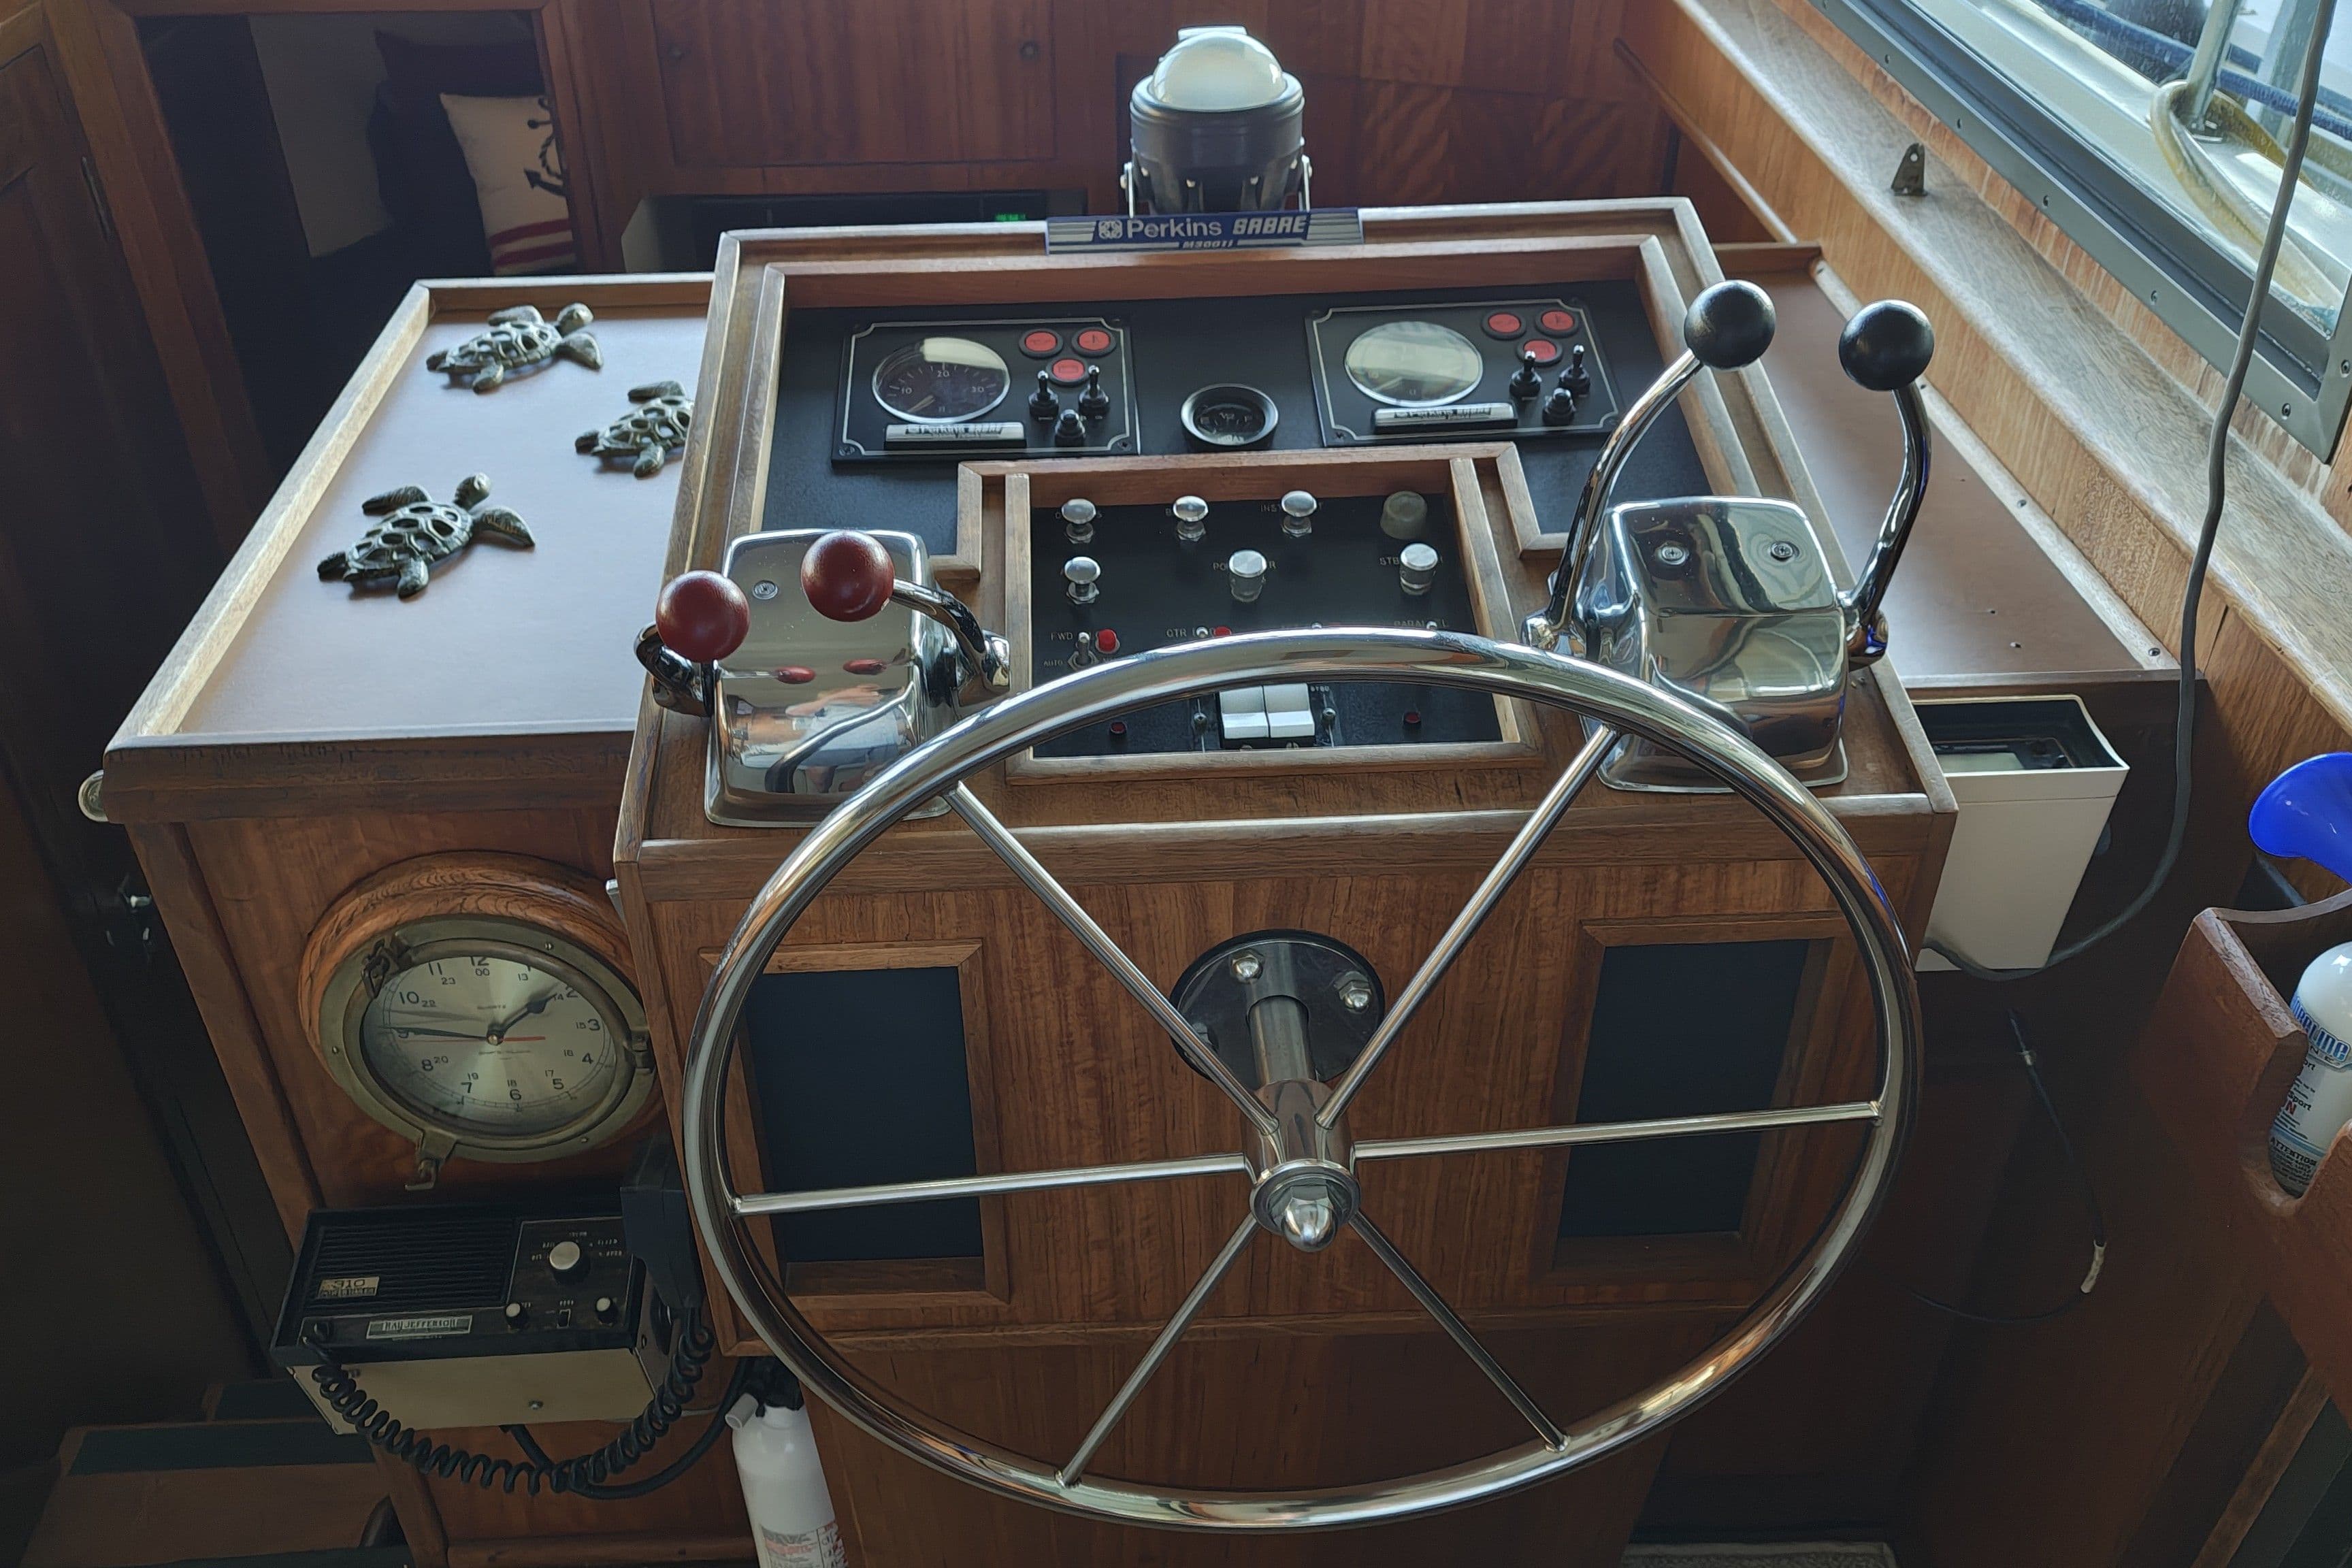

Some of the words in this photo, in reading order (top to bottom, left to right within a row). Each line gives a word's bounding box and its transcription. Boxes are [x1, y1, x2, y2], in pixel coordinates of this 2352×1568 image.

[1127, 218, 1222, 238] Perkins
[428, 962, 442, 975] 11
[475, 968, 490, 977] 00
[399, 991, 419, 1004] 10
[587, 1019, 600, 1031] 3
[582, 1053, 593, 1064] 4
[422, 1059, 434, 1071] 8
[461, 1082, 472, 1093] 7
[553, 1078, 564, 1090] 5
[510, 1089, 521, 1100] 6
